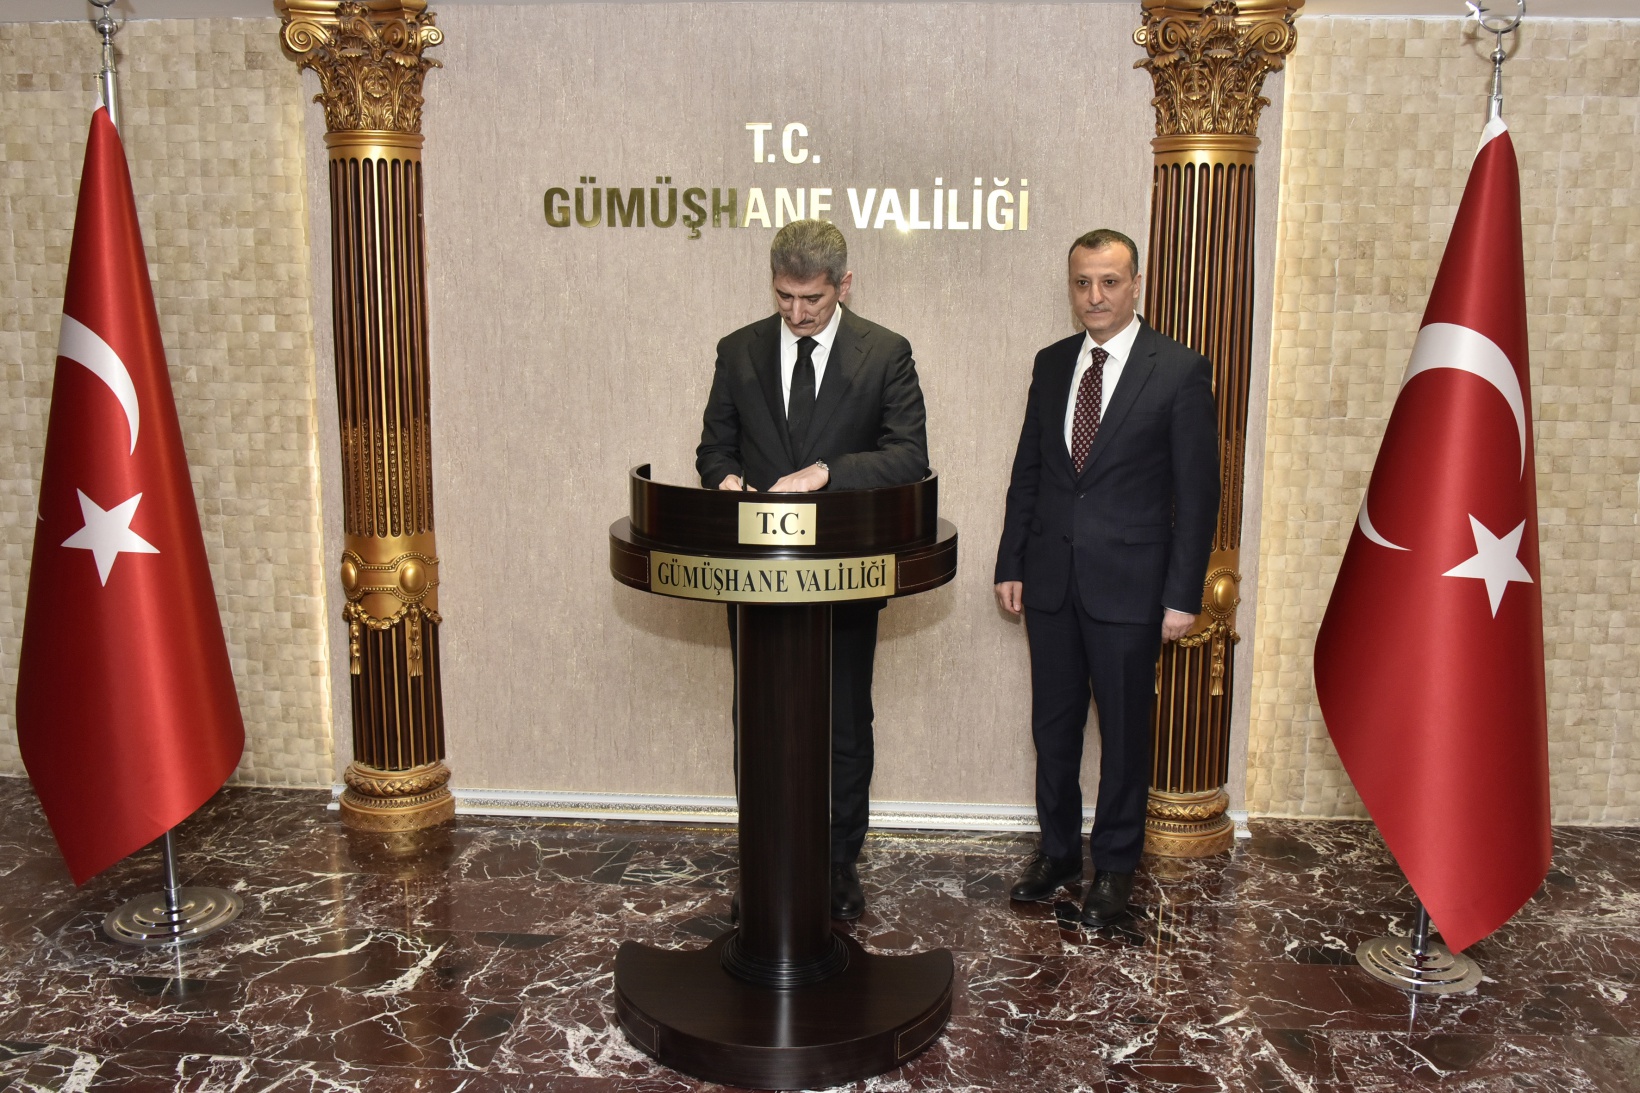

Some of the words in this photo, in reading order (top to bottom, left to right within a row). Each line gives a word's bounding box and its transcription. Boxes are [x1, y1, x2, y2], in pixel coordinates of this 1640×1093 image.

[745, 122, 821, 164] T.C.
[543, 175, 833, 240] GÜMÜŞHANE
[846, 176, 1029, 231] VALİLİĞİ
[756, 511, 806, 535] T.C.
[657, 558, 789, 595] GÜMÜŞHANE
[796, 559, 887, 593] VALİLİĞİ
